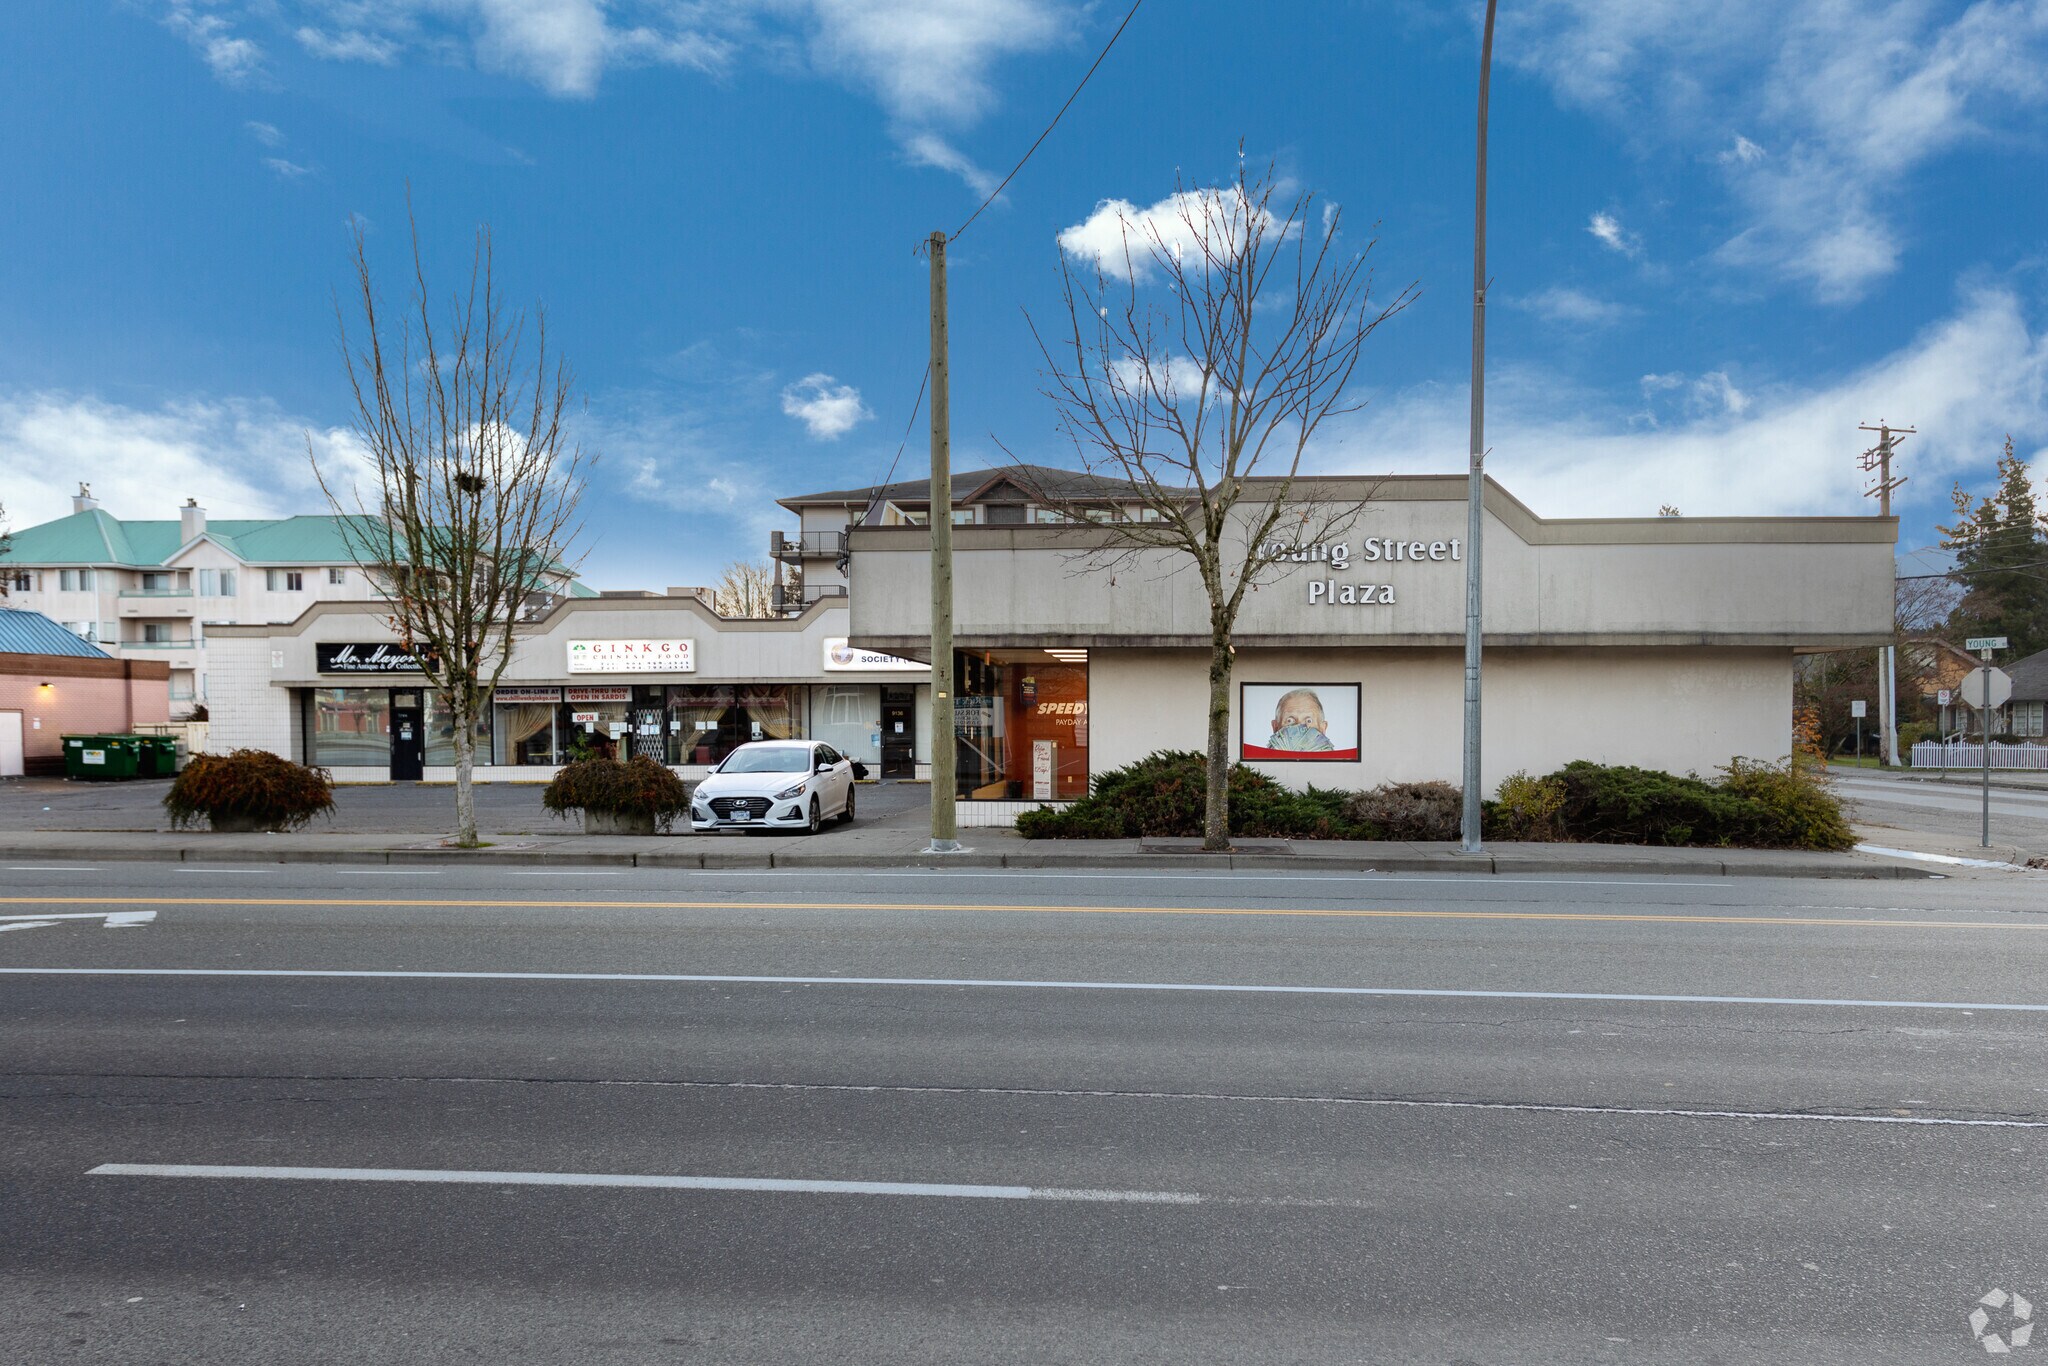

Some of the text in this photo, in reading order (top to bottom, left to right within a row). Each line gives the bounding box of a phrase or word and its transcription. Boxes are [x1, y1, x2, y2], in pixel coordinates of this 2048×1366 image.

[1364, 537, 1461, 561] Street
[1308, 579, 1396, 604] Plaza
[593, 643, 688, 653] GINKGO
[1967, 640, 1997, 648] YOUNG
[330, 645, 360, 663] Mr.
